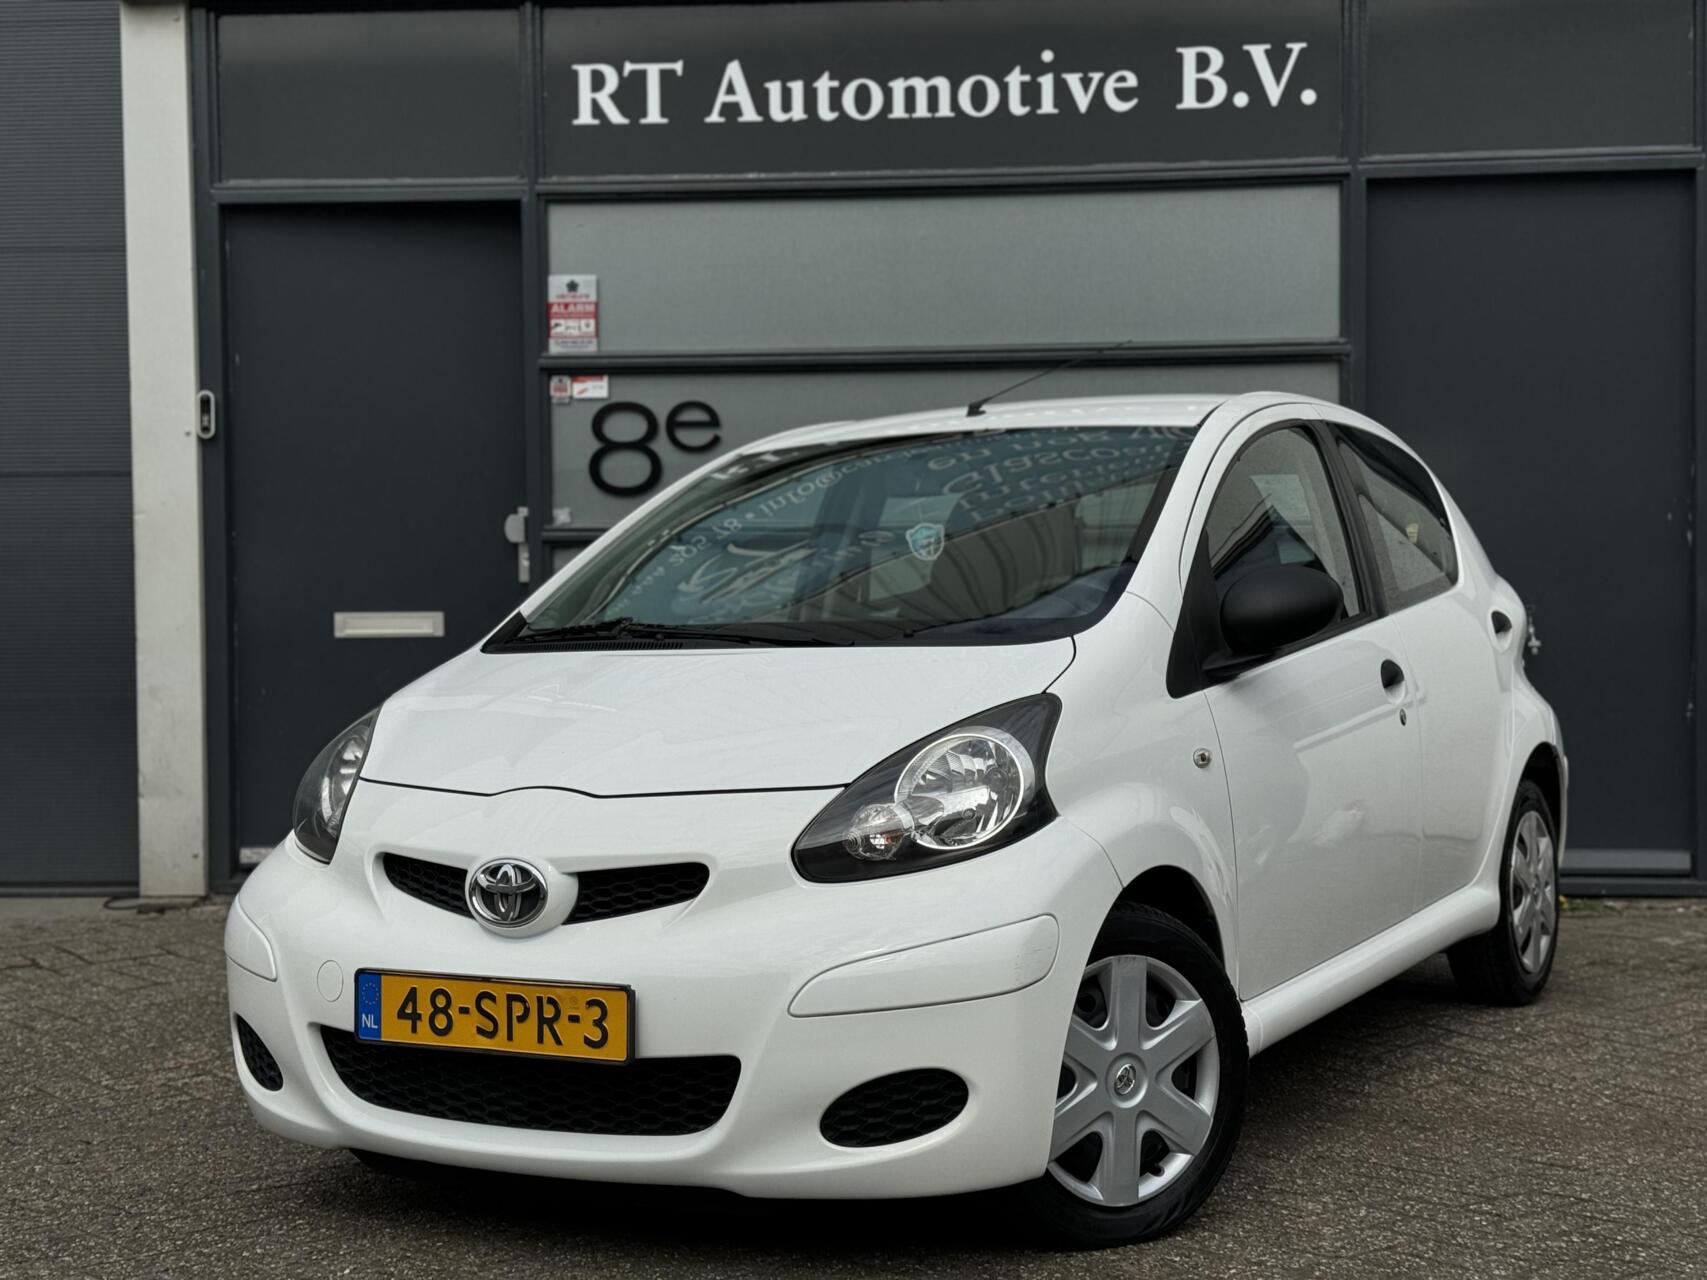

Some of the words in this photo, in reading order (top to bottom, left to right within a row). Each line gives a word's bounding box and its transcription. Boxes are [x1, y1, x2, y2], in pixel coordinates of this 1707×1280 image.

[571, 59, 683, 126] RT
[704, 49, 1138, 123] Automotive
[1176, 42, 1317, 110] B.V.
[551, 303, 596, 314] ALARM
[361, 1012, 379, 1030] NL
[396, 986, 610, 1050] 48-SPR-3
